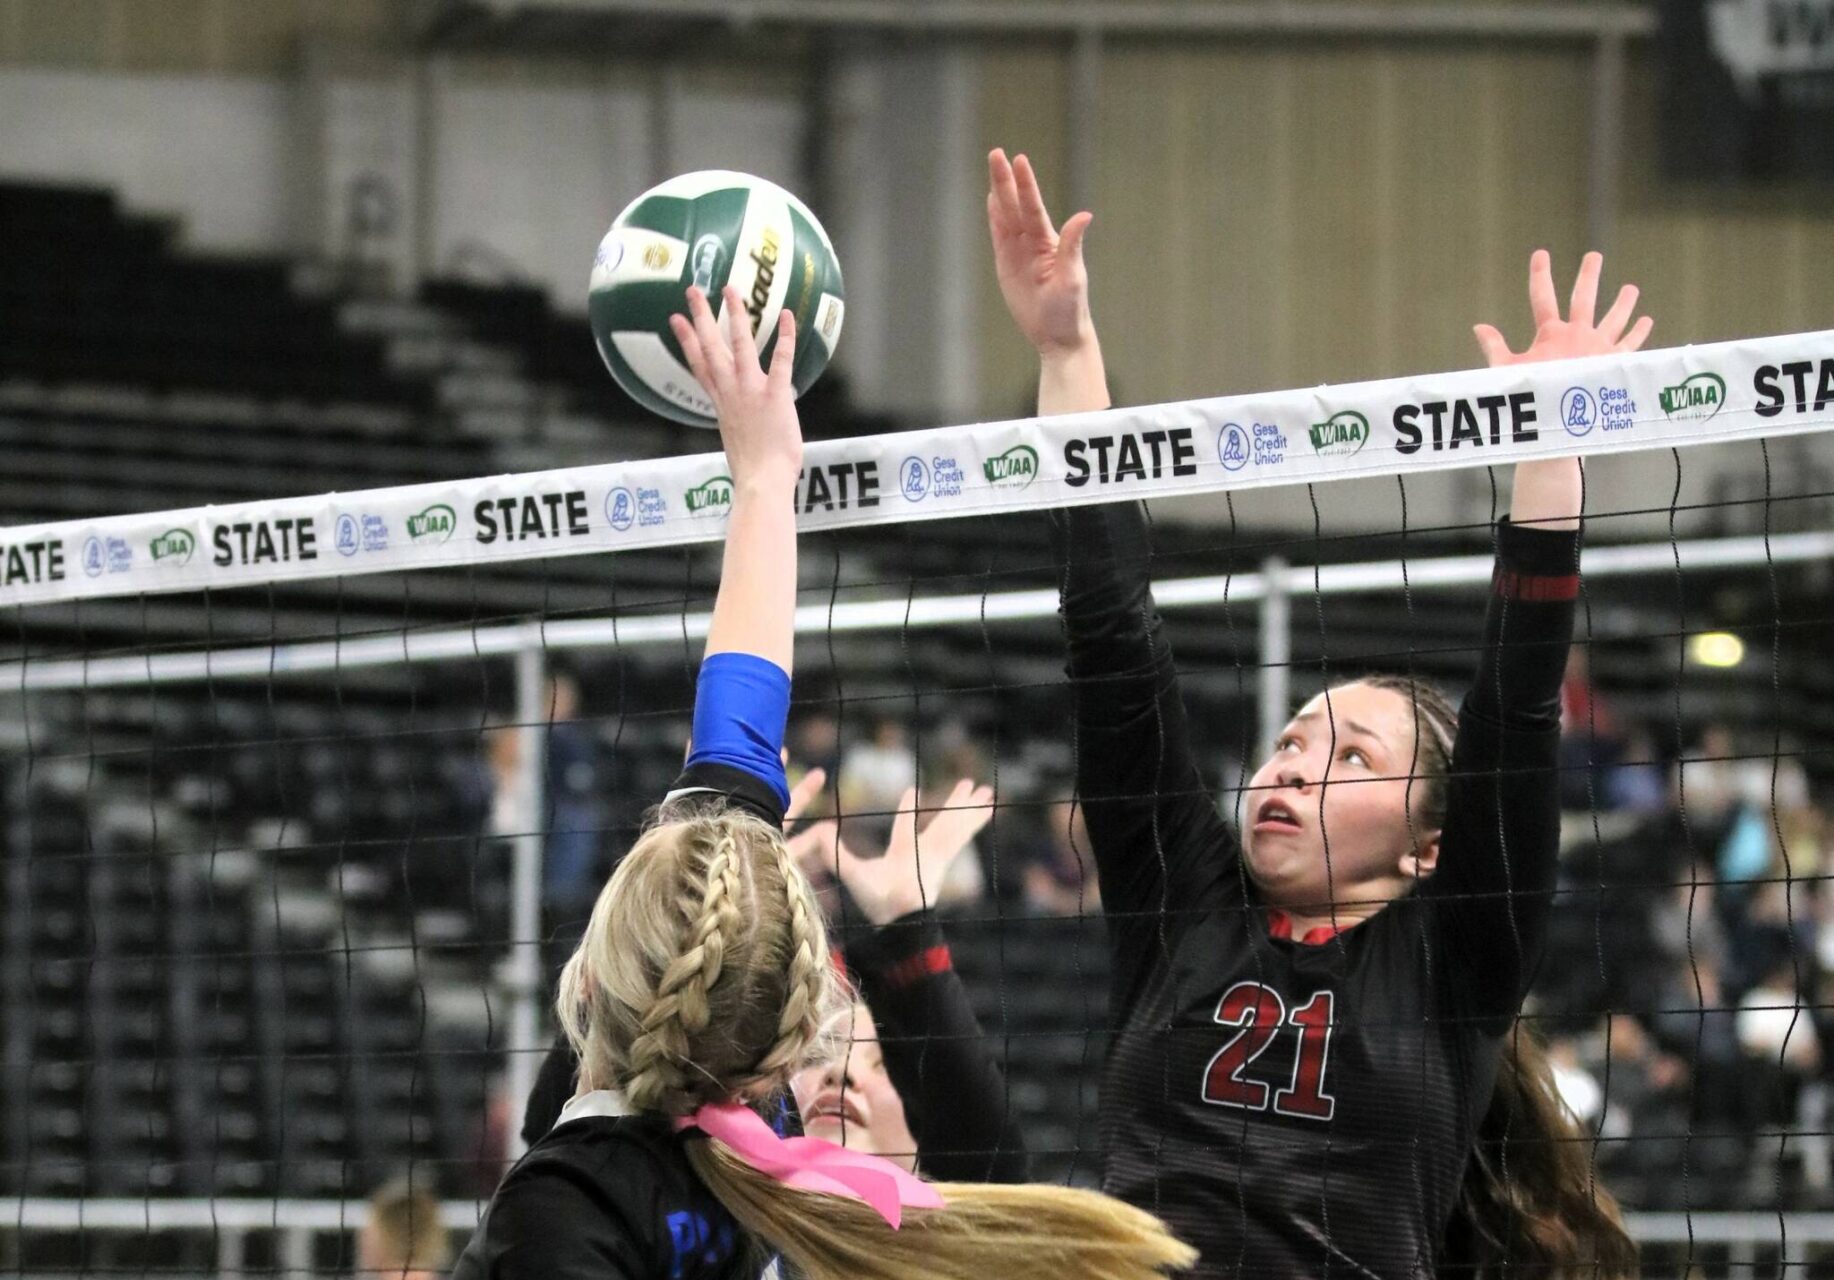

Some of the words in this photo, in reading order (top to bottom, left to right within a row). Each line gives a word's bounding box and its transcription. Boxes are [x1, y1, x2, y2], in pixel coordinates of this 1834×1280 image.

[1599, 386, 1628, 402] Gesa
[1671, 385, 1718, 411] WIAA
[1601, 400, 1637, 417] Credit
[1253, 422, 1279, 437] Gesa
[1392, 391, 1539, 455] STATE
[1602, 416, 1633, 431] Union
[1319, 423, 1361, 446] WIAA
[1254, 436, 1287, 451] Credit
[933, 456, 957, 470] Gesa
[1064, 428, 1197, 487] STATE
[1254, 451, 1284, 466] Union
[934, 469, 964, 484] Credit
[991, 456, 1032, 480] WIAA
[636, 487, 659, 500] Gesa
[934, 483, 962, 497] Union
[638, 501, 666, 514] Credit
[694, 488, 730, 510] WIAA
[413, 515, 449, 536] WIAA
[474, 490, 590, 544] STATE
[639, 514, 664, 527] Union
[213, 517, 318, 567] STATE
[0, 540, 65, 586] ATE
[1201, 980, 1335, 1121] 21
